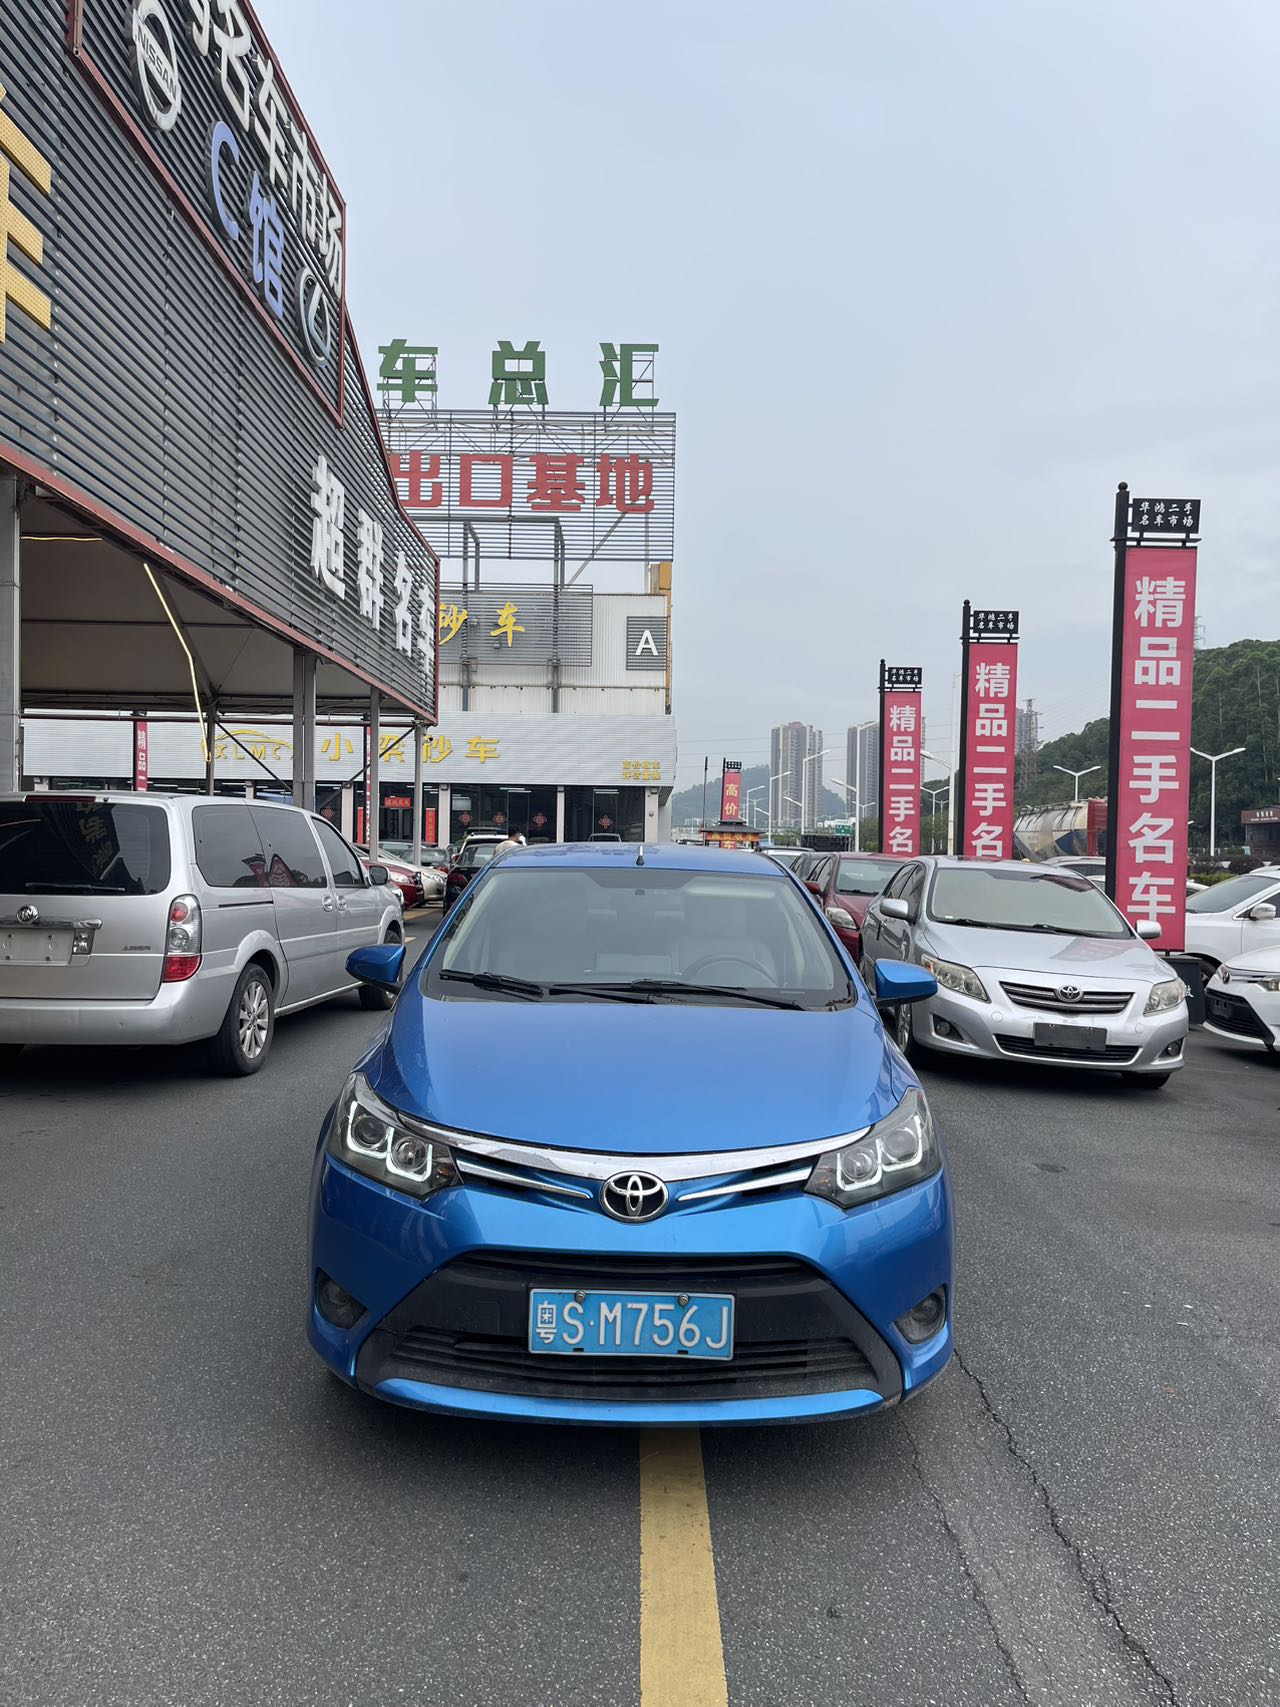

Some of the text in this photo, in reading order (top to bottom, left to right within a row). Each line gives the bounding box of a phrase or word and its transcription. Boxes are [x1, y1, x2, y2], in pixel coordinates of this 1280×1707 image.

[136, 30, 178, 98] NISSAN
[377, 339, 660, 407] 车总汇
[388, 450, 654, 512] 出口基地
[1139, 501, 1193, 514] 华鸿二手
[1139, 514, 1194, 527] 名车市场
[635, 629, 659, 656] A
[888, 704, 917, 853] 精品二手名
[971, 662, 1011, 857] 精品二手名
[1127, 576, 1186, 922] 精品二手名车
